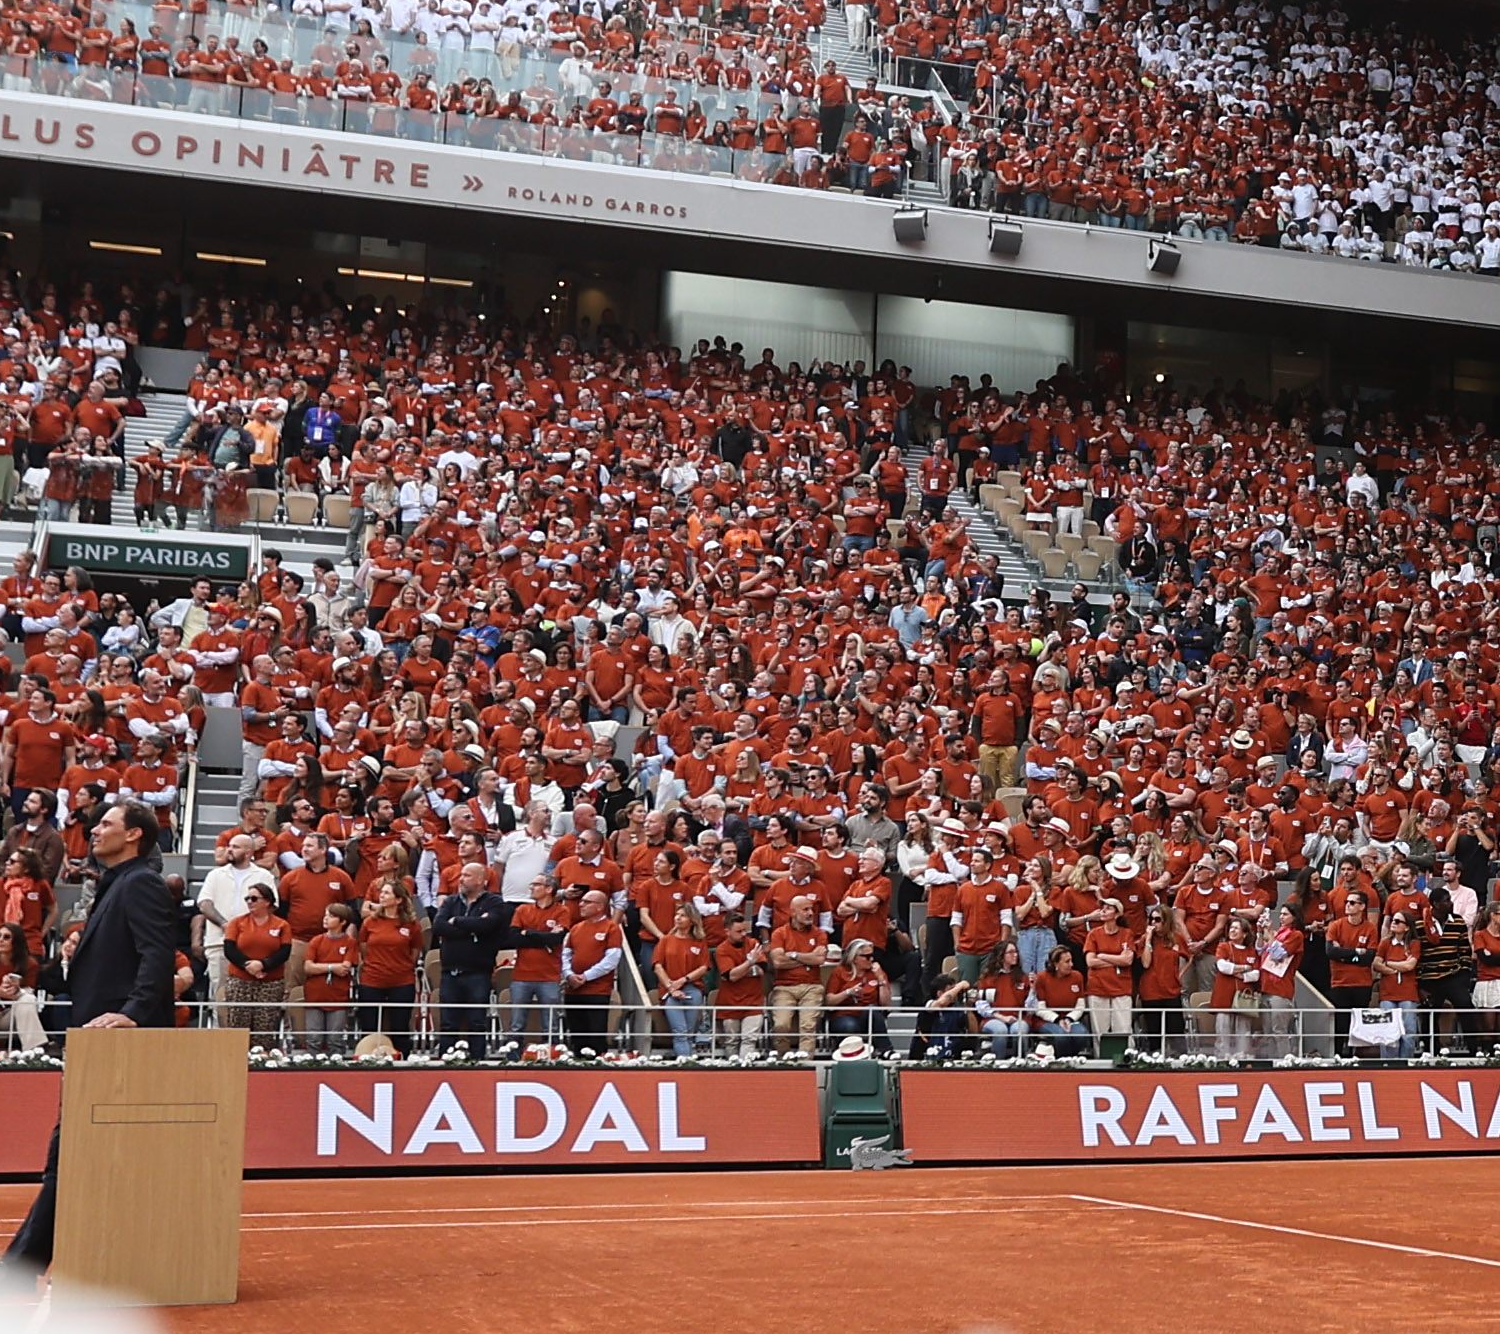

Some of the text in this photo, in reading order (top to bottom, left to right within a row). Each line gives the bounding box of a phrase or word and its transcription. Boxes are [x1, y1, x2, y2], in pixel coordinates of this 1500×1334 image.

[131, 129, 430, 188] OPINIÂTRE
[508, 185, 689, 219] ROLAND GARROS
[66, 542, 231, 569] BNP PARIBAS
[316, 1081, 707, 1156] NADAL
[1077, 1081, 1400, 1147] RAFAEL
